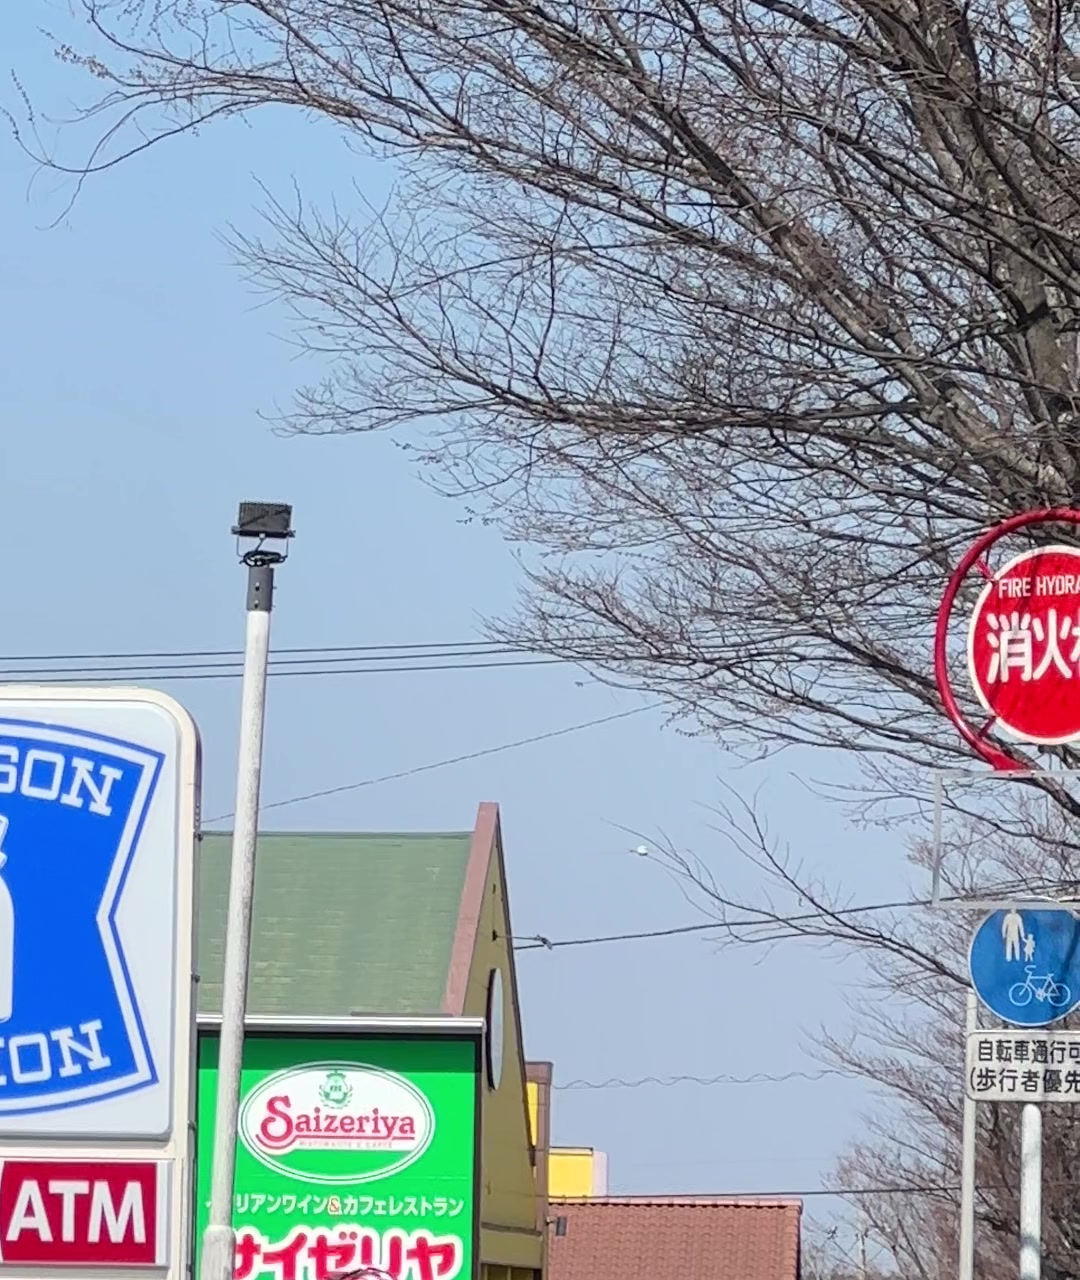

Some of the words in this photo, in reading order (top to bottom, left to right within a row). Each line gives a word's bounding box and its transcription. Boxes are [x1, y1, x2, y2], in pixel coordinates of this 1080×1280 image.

[998, 577, 1032, 599] FIRE
[257, 1095, 416, 1146] Saizeriya
[5, 1180, 147, 1244] ATM
